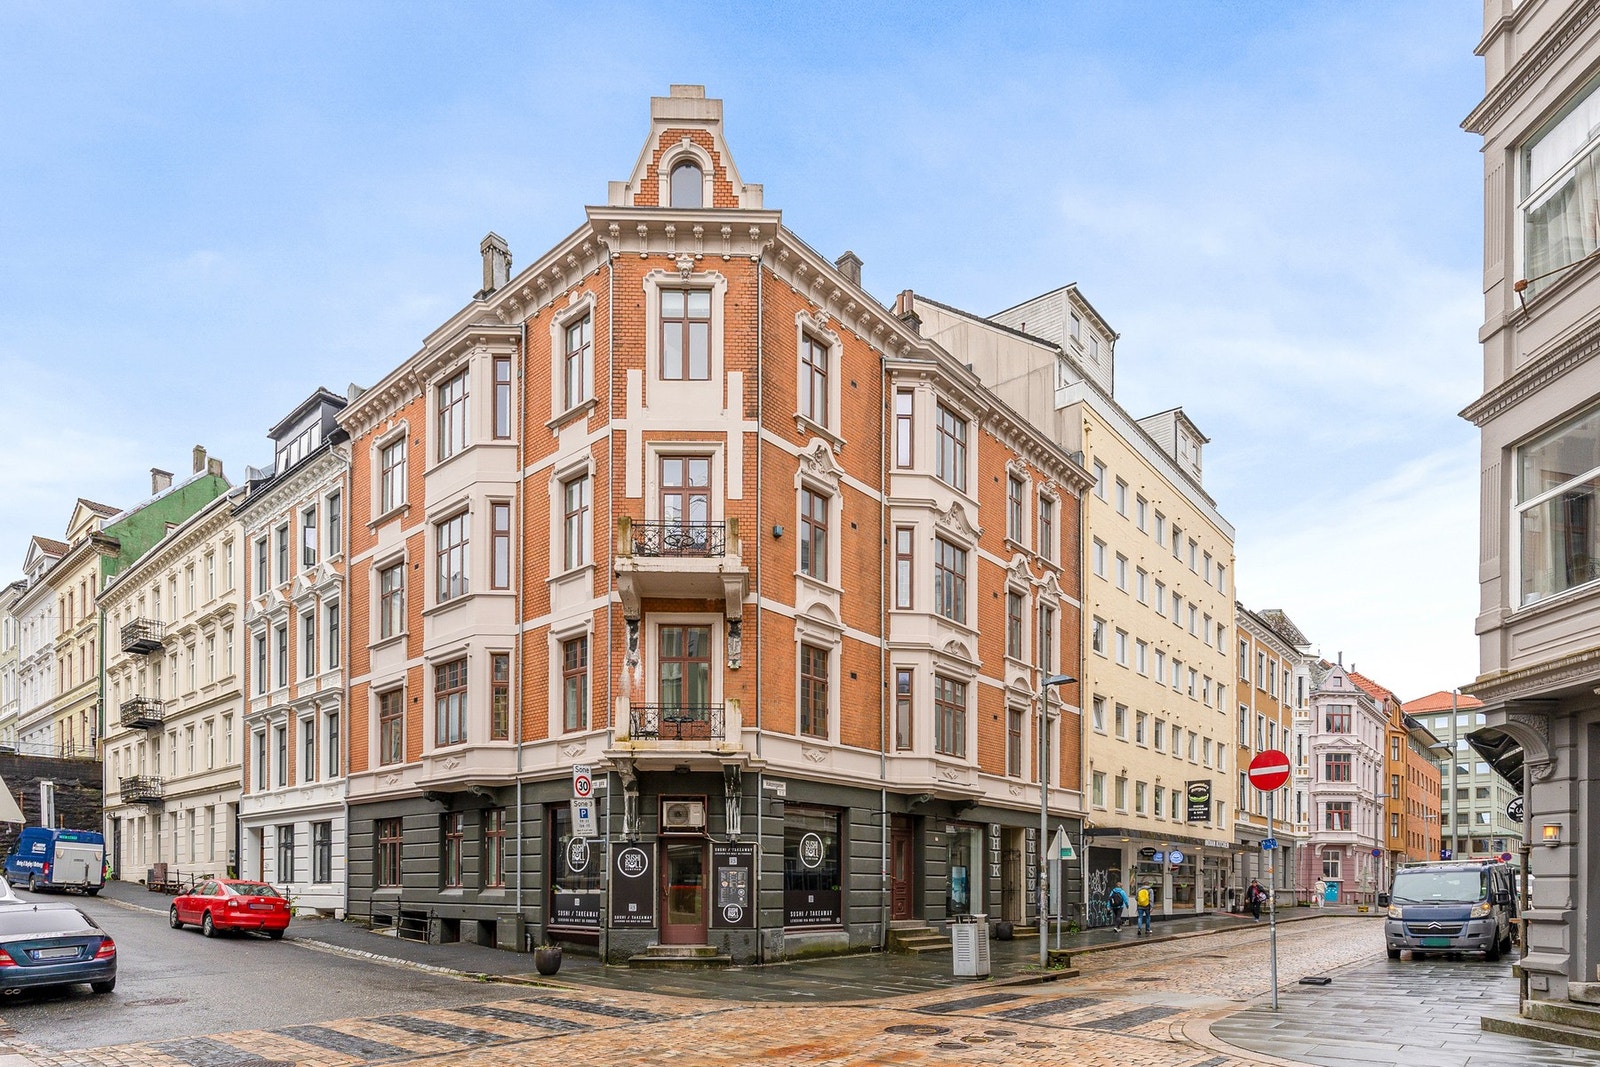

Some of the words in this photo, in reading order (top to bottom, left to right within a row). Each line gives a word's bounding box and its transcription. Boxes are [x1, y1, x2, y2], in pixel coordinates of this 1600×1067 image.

[574, 766, 590, 774] Sone
[578, 780, 588, 791] 30
[805, 840, 819, 848] SUSHI
[805, 848, 820, 857] ROLL
[992, 824, 1000, 876] CHIK
[625, 860, 642, 868] ROLL
